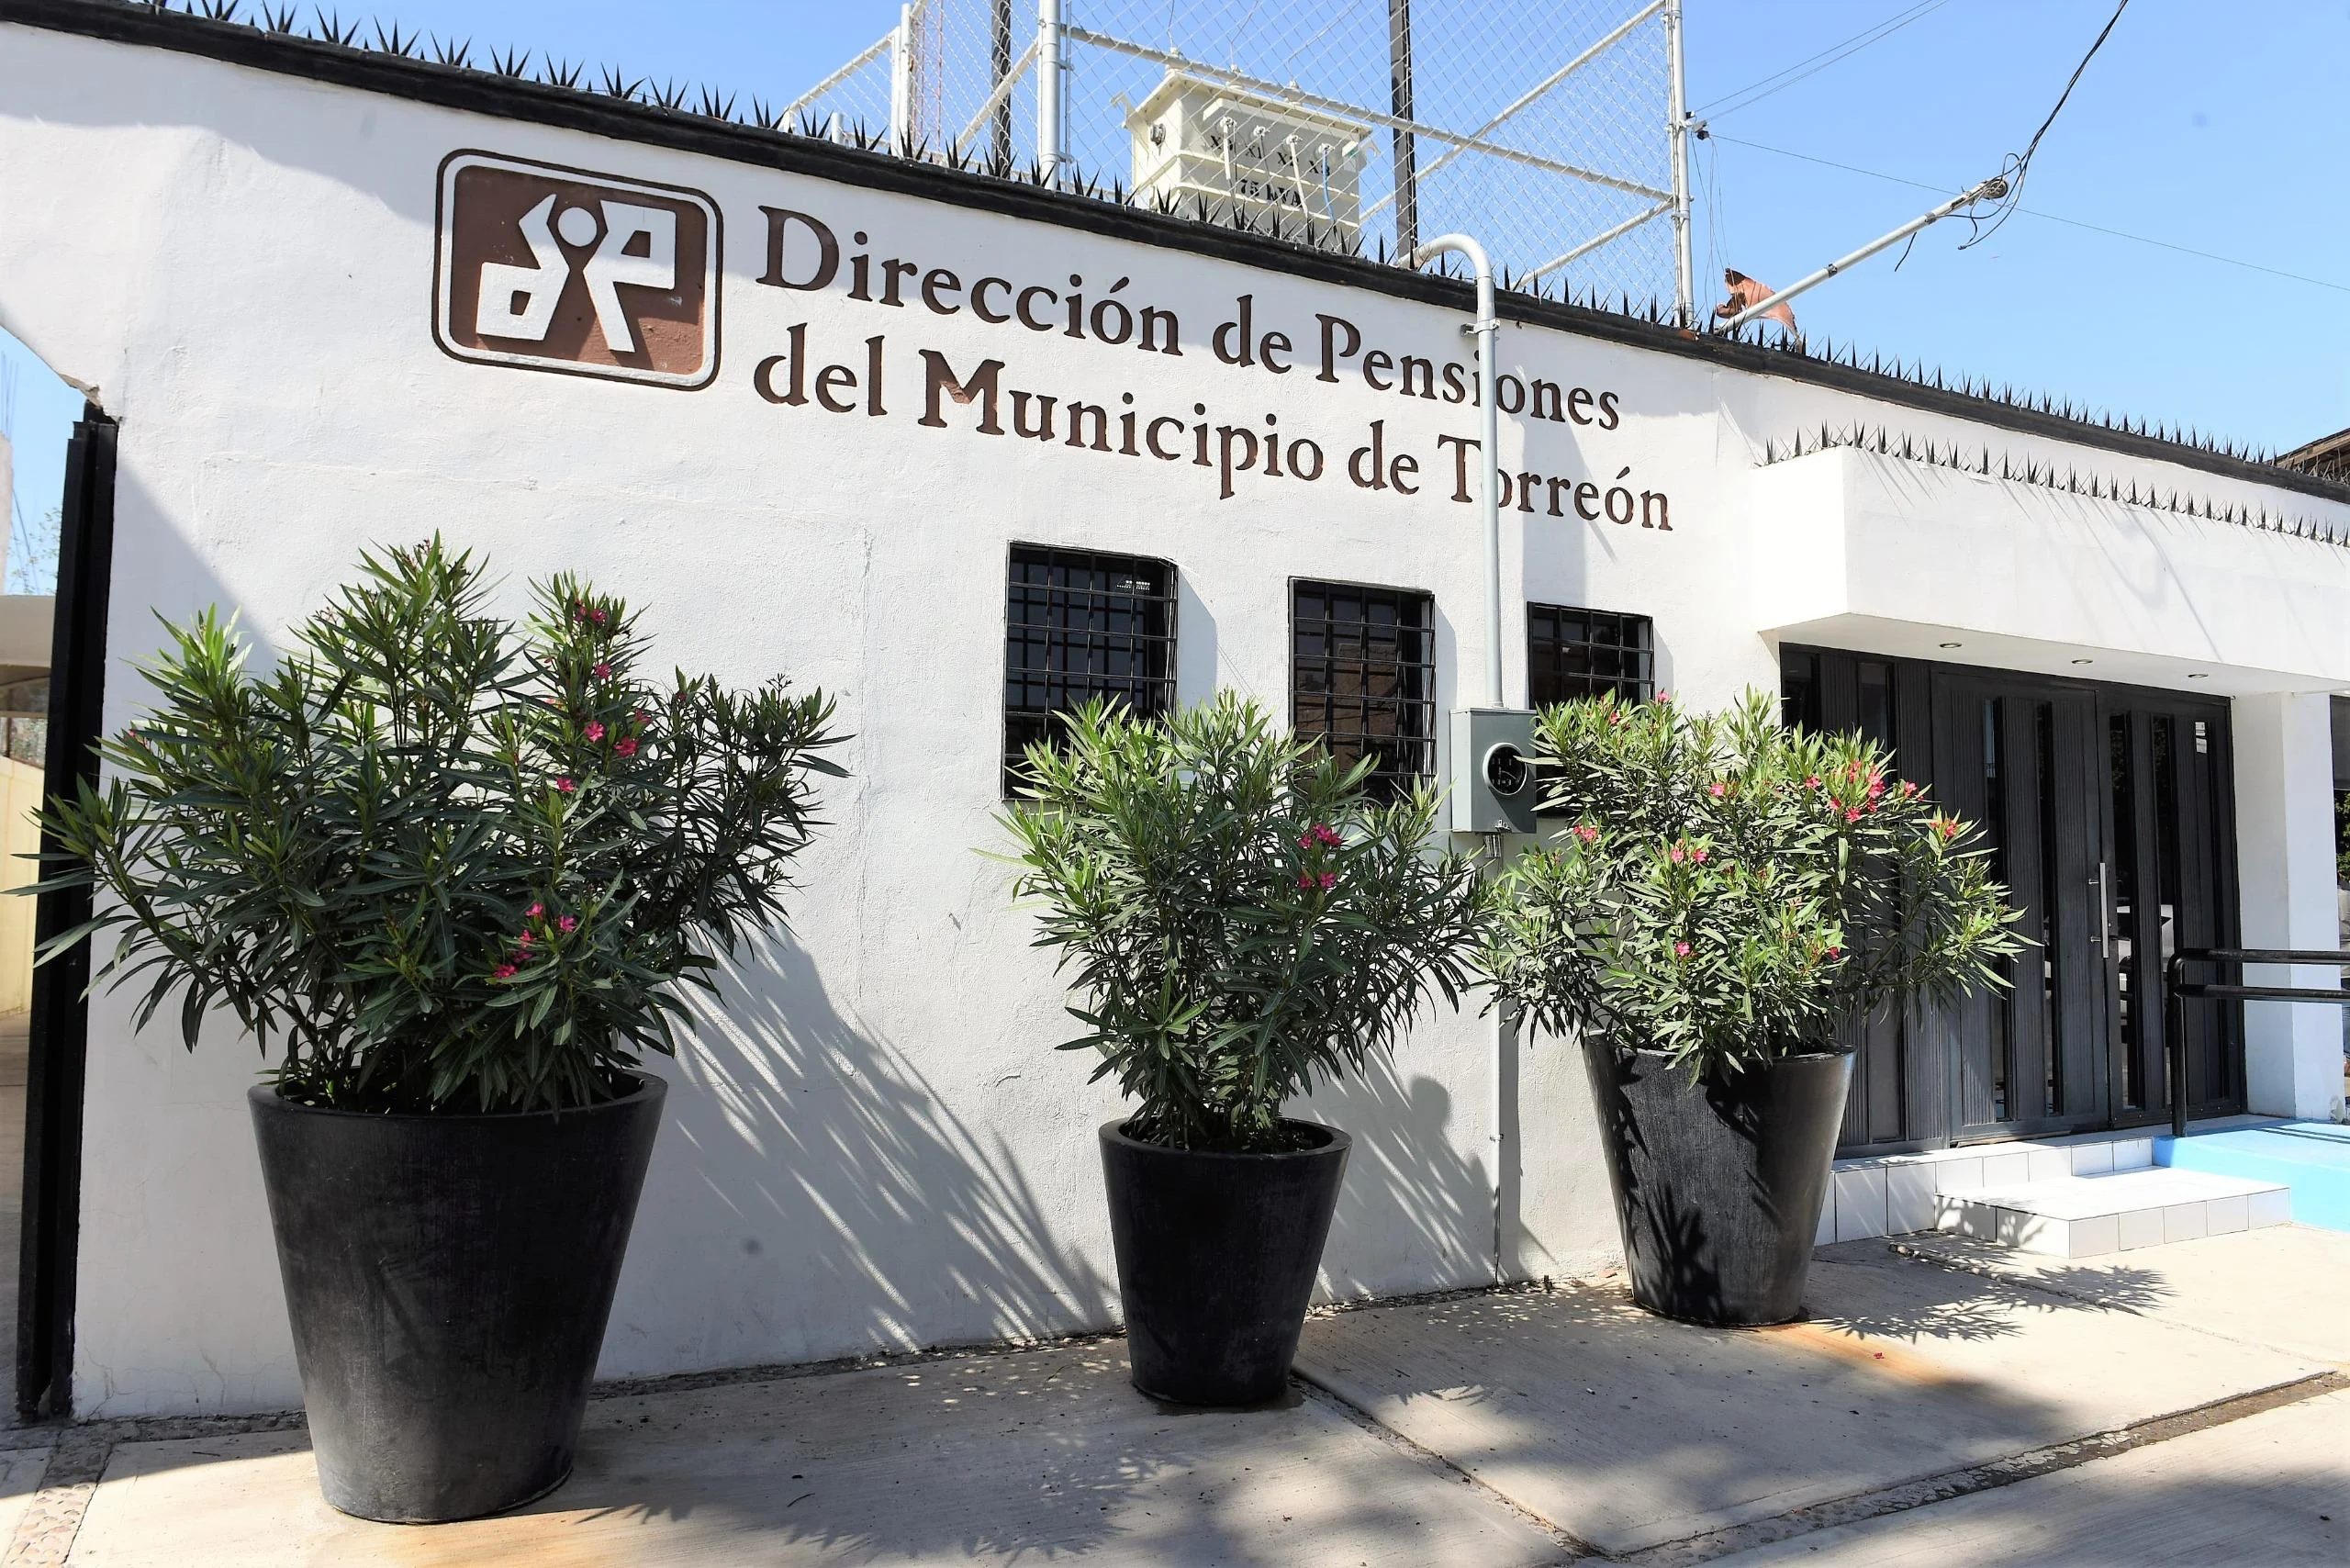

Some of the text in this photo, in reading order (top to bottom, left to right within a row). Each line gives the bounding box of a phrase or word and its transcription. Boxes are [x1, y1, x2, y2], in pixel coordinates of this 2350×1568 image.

[1240, 178, 1259, 197] 75
[755, 205, 1619, 431] Dirección de Pensiones
[753, 322, 889, 417] del
[917, 348, 1324, 500] Municipio
[1348, 419, 1420, 496] de
